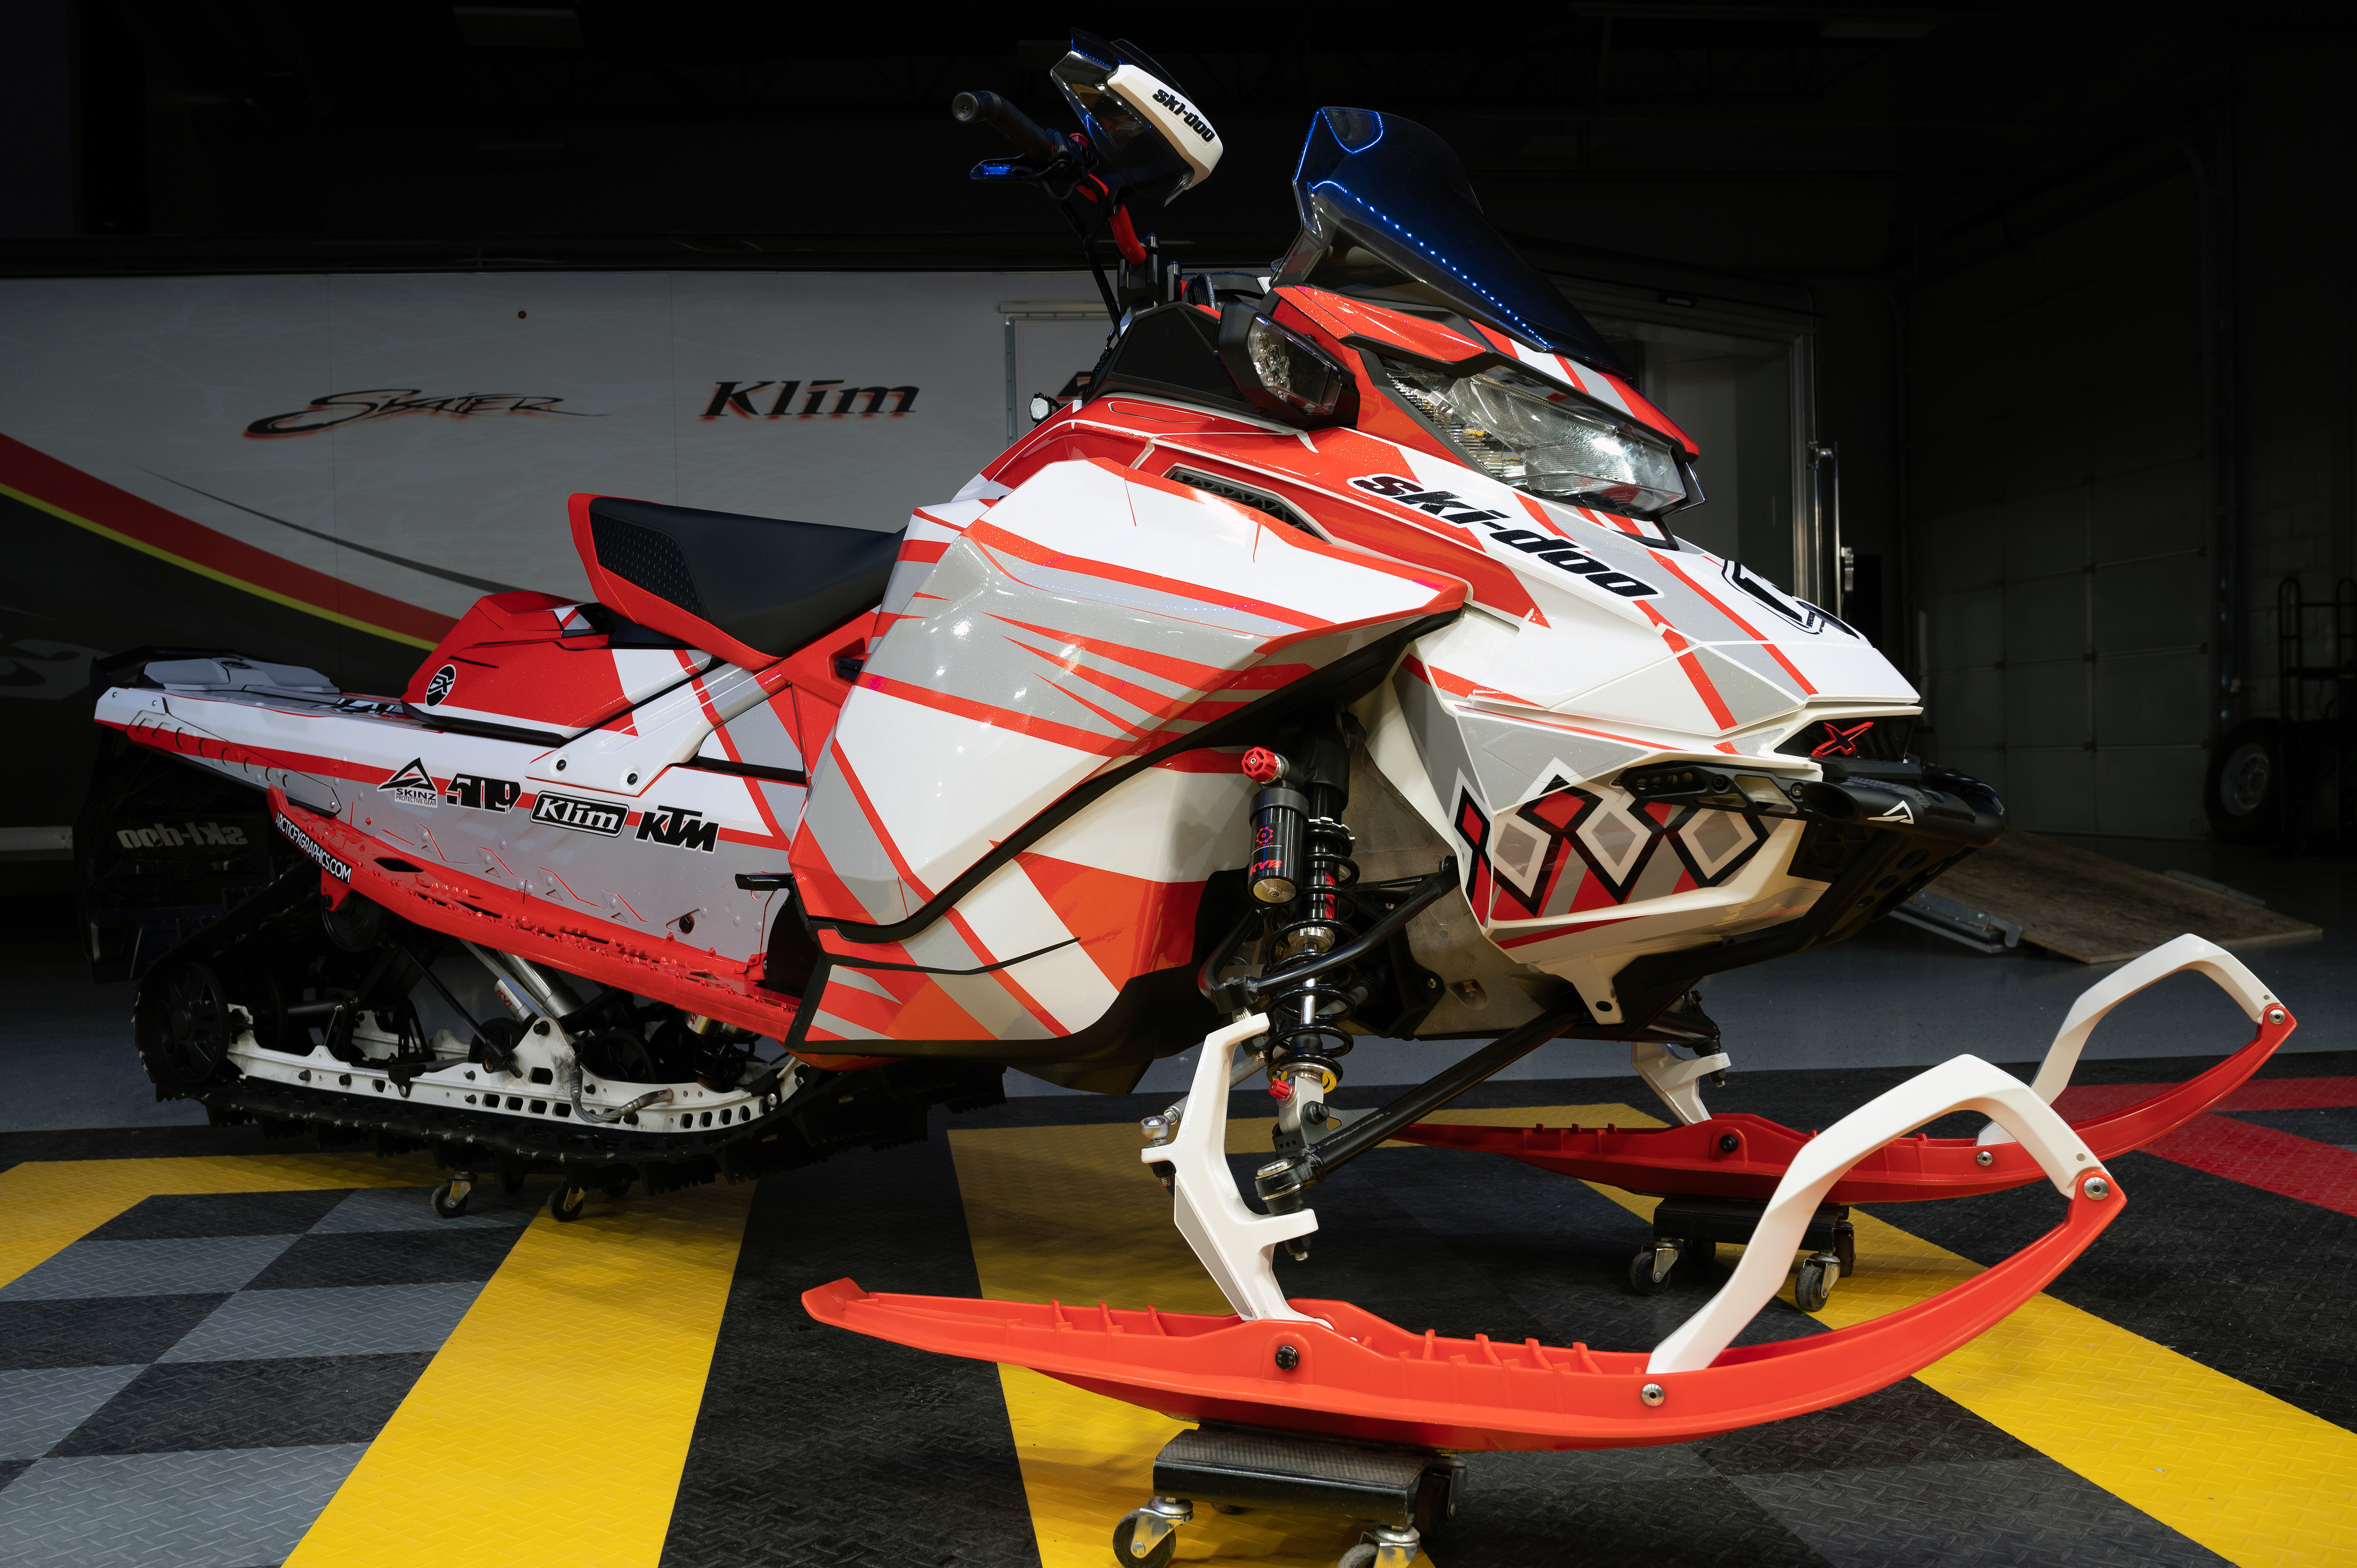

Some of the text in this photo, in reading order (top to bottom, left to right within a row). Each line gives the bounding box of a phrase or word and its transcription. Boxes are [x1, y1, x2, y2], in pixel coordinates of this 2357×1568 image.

[1352, 476, 1659, 597] ski-doo
[396, 788, 436, 801] SKINZ
[396, 795, 423, 804] PROTECTIVE
[275, 811, 352, 883] ARCTICFXGRAPHICS.COM
[635, 805, 719, 852] KTM
